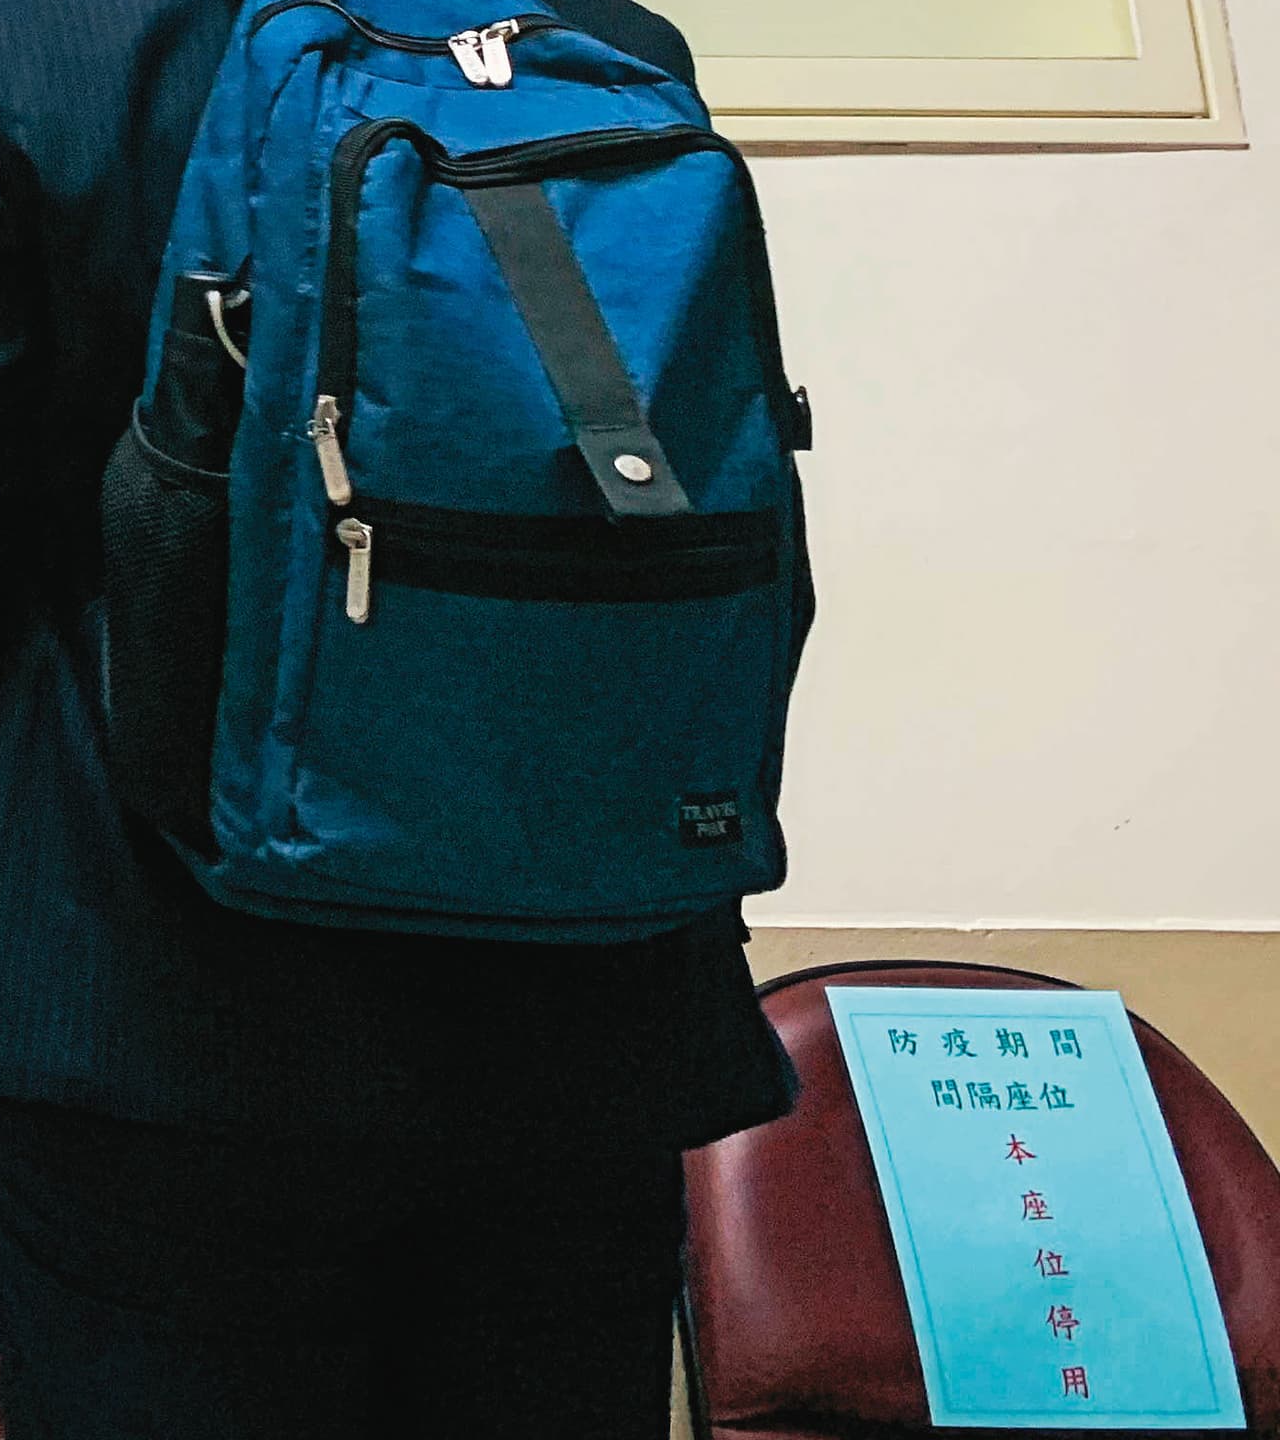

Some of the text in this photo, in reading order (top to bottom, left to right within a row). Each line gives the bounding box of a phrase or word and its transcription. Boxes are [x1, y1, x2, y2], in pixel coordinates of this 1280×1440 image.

[887, 1028, 1083, 1059] 防疫期間
[930, 1078, 1076, 1111] 間隔座位
[1004, 1133, 1090, 1399] 本座位停用
